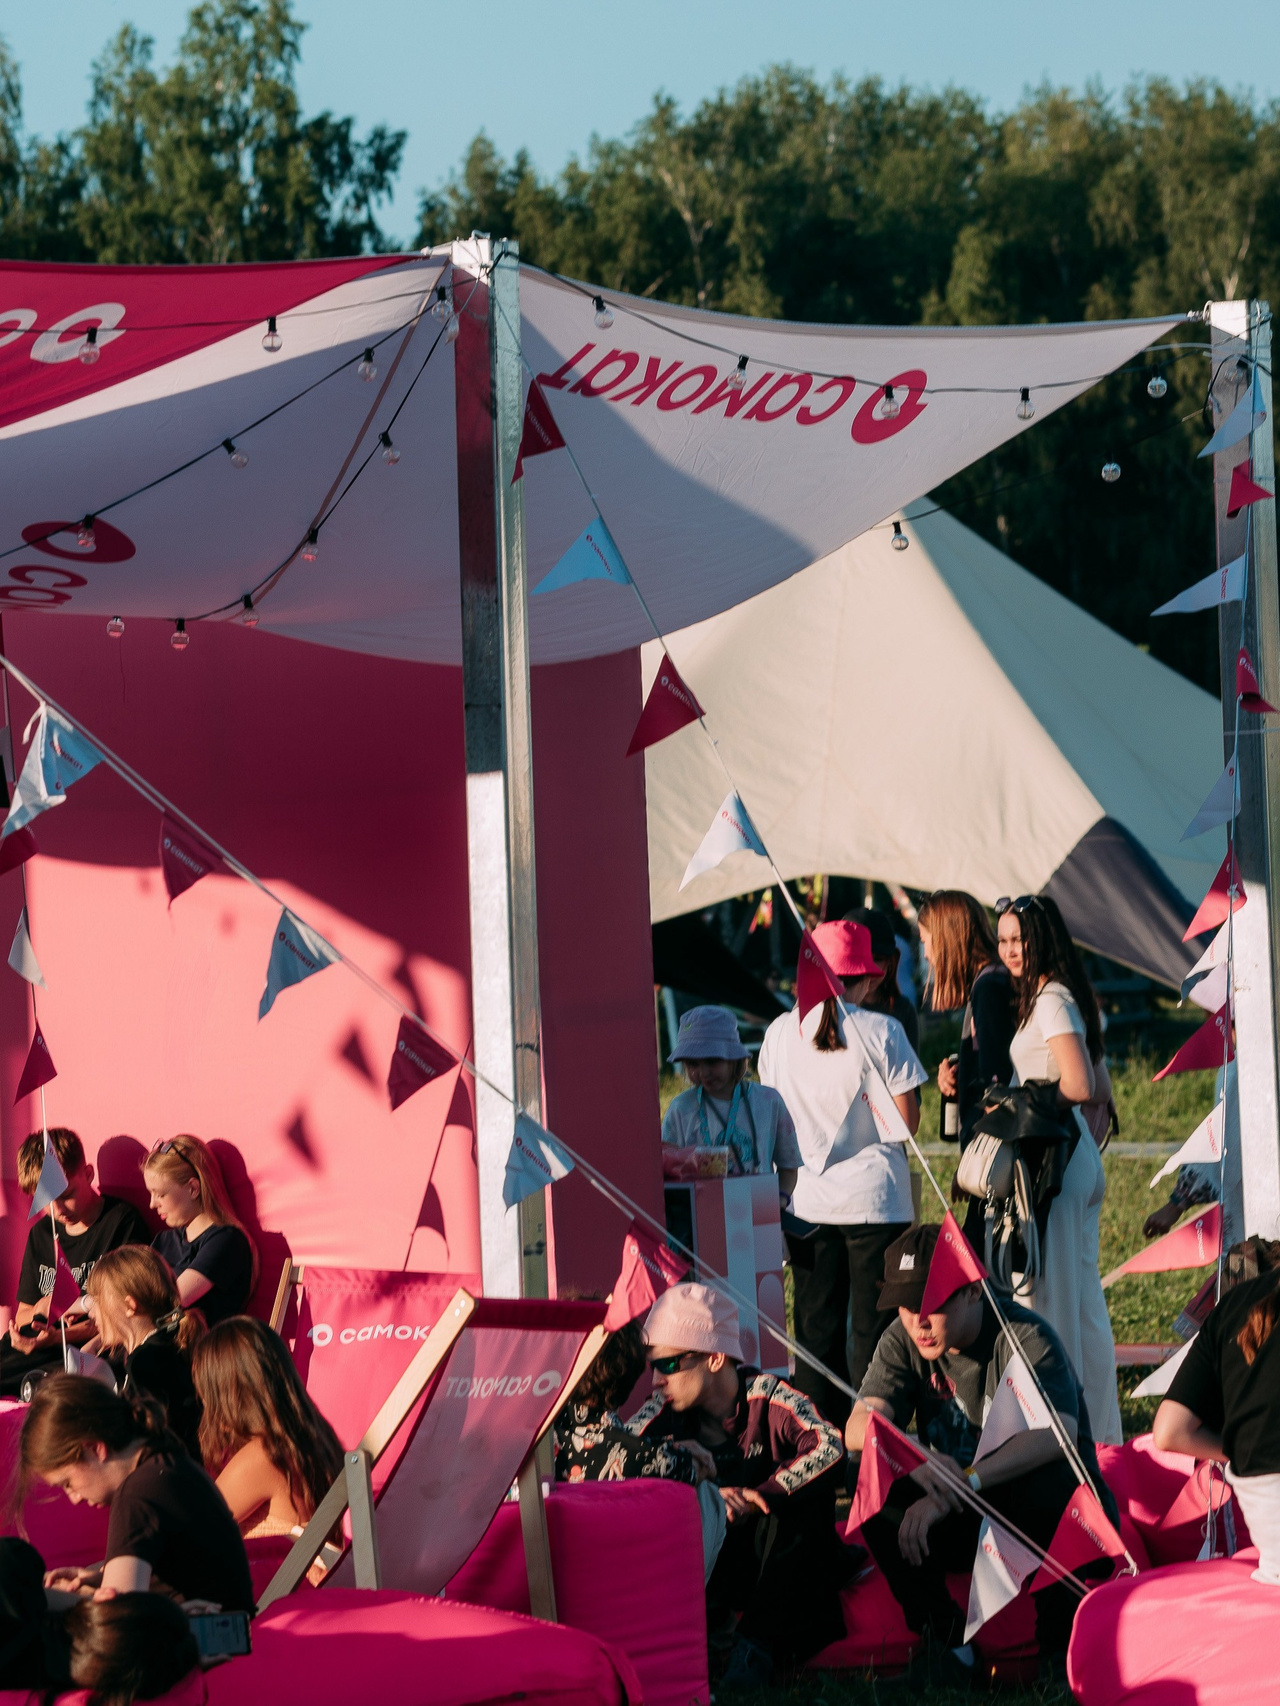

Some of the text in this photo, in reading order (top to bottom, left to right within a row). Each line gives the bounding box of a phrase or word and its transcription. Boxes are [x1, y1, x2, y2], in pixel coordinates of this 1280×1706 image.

[536, 342, 855, 426] самокат
[283, 938, 316, 971] самокат
[404, 1047, 437, 1076] самокат
[340, 1323, 431, 1346] самок
